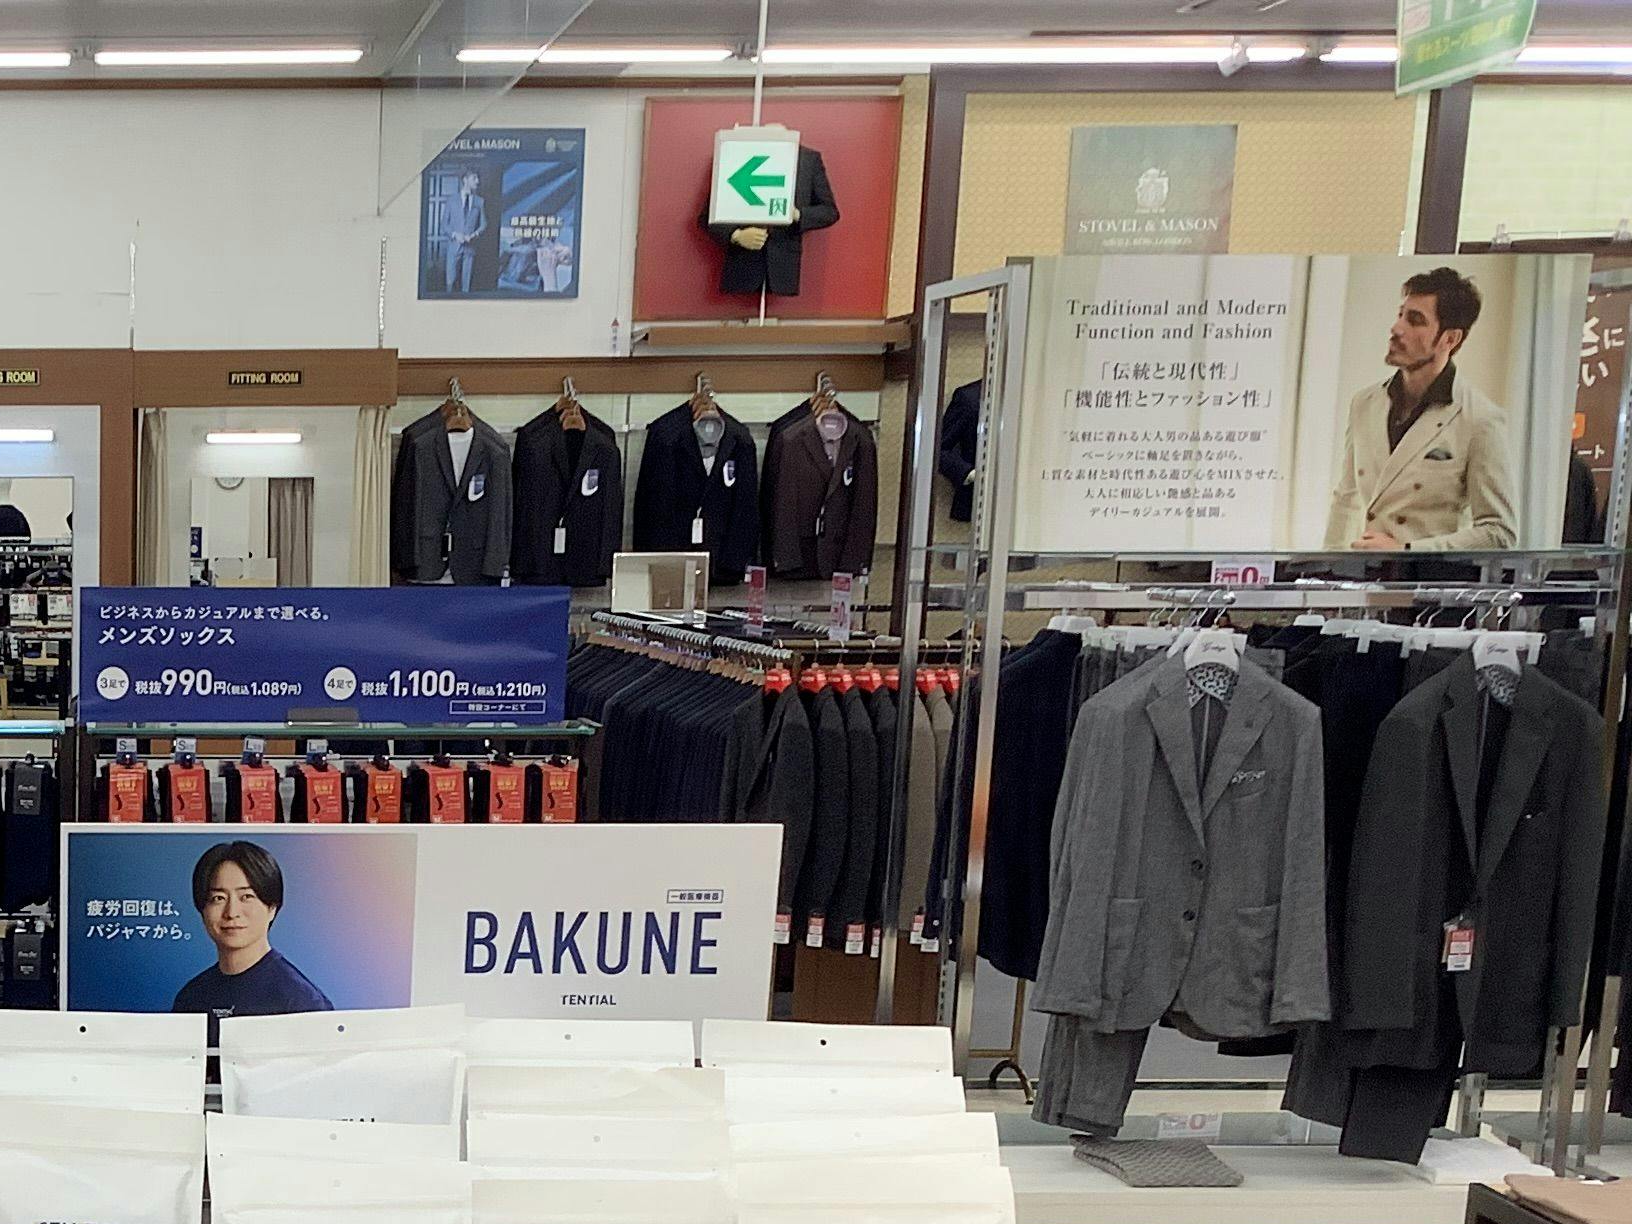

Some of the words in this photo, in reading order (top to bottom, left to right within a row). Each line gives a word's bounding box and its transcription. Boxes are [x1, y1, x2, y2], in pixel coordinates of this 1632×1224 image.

[1079, 219, 1142, 233] STOVEL
[1145, 219, 1156, 232] &
[1160, 218, 1218, 232] MASON
[1067, 299, 1168, 316] Traditional
[1176, 299, 1208, 315] and
[1218, 299, 1287, 315] Modern
[1075, 323, 1154, 339] Function
[1162, 323, 1193, 339] and
[1203, 323, 1272, 339] Fashion
[6, 372, 36, 383] ROOM
[231, 373, 266, 384] FITTING
[270, 373, 299, 384] ROOM
[1100, 361, 1239, 381] 「伝統と現代性」
[1064, 389, 1272, 408] 「機能性とファッション性」
[100, 606, 329, 620] ビジネスからカジュアルまで選べる。
[98, 626, 236, 645] メンズソックス
[100, 677, 126, 689] 3足で
[327, 678, 354, 689] 4足で
[86, 899, 179, 917] 疲労回復は、
[86, 923, 192, 940] パジャマから。
[464, 911, 722, 975] BAKUNE
[562, 995, 616, 1005] TENTIAL
